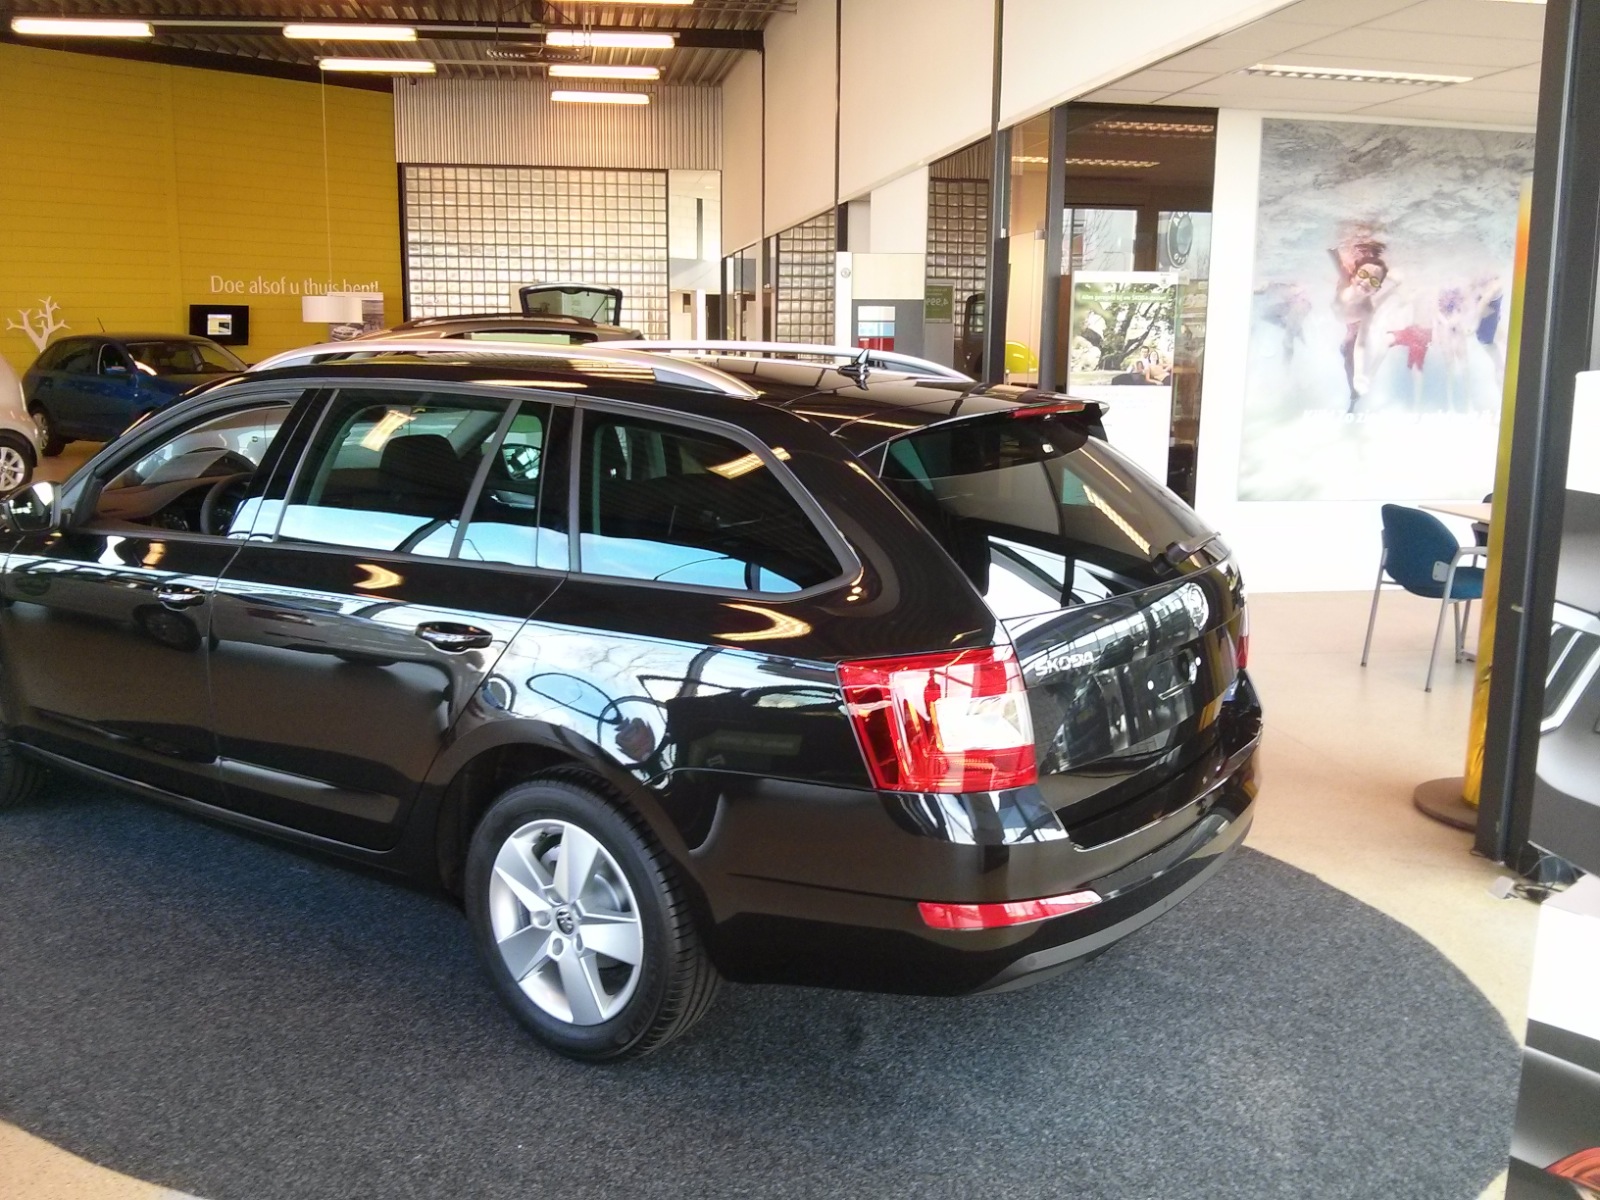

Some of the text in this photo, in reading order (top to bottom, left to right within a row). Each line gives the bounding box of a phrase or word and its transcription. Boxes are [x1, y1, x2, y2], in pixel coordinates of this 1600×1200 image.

[210, 275, 245, 294] Doe
[249, 276, 286, 295] alsof
[290, 282, 300, 295] u
[304, 277, 340, 296] thuis
